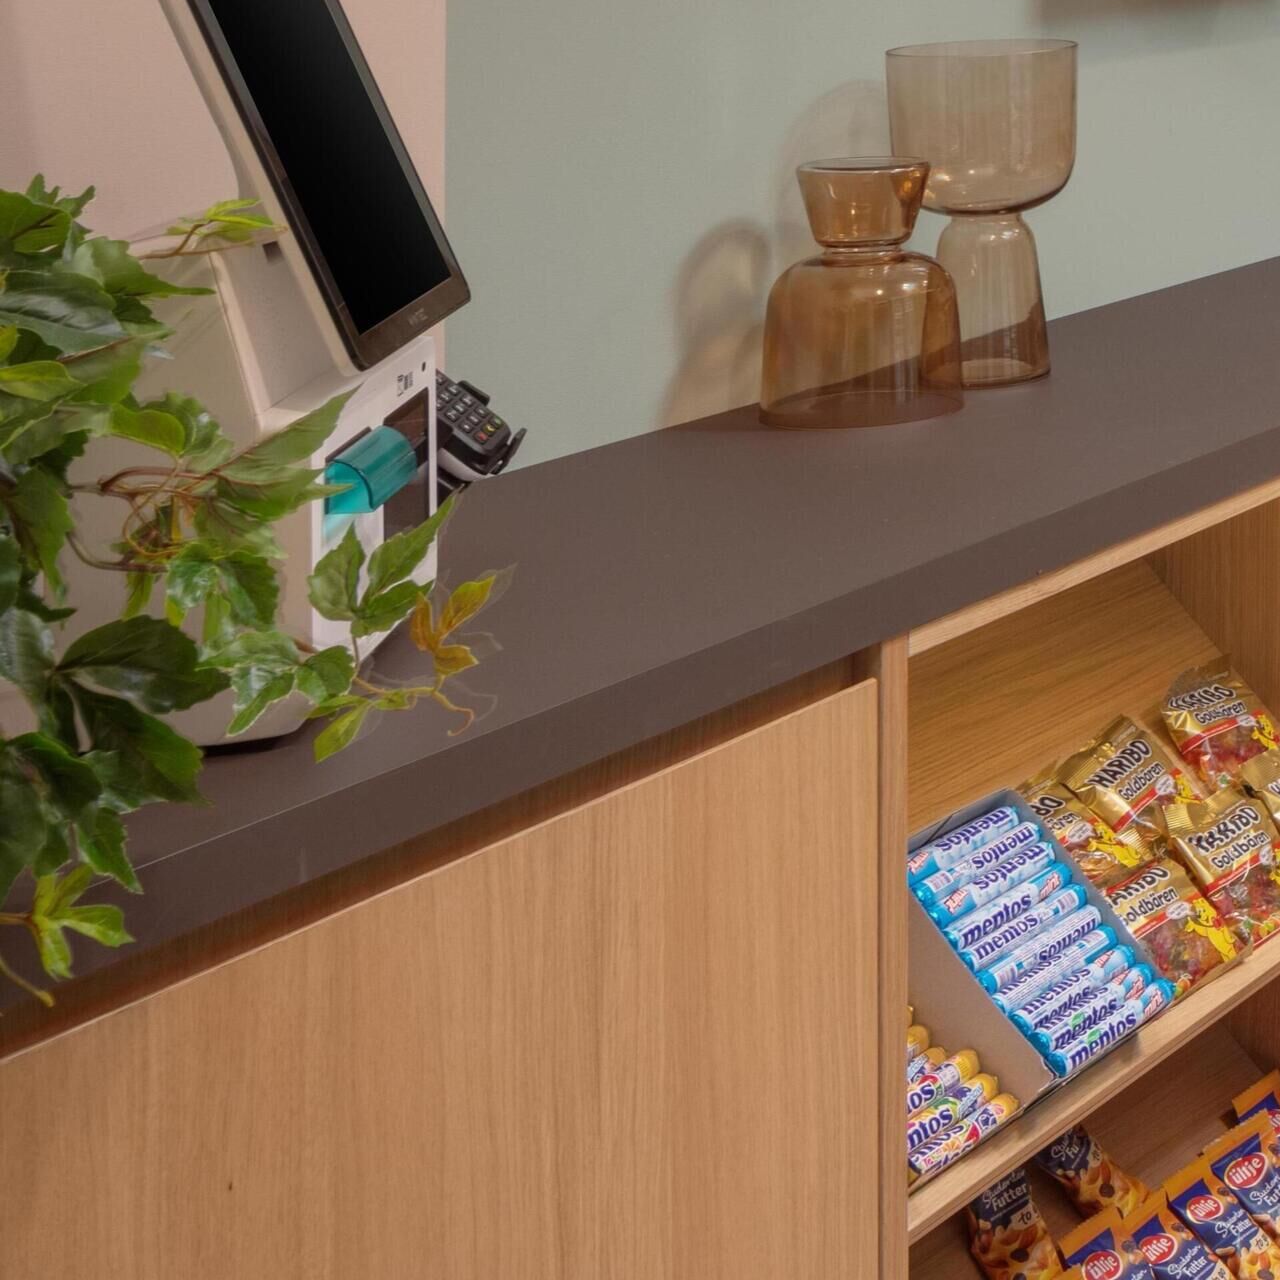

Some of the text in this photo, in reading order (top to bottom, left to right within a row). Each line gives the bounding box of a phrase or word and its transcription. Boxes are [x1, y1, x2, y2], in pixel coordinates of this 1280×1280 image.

[1169, 684, 1235, 712] HARIBO
[1086, 739, 1151, 788] HARIBO
[1118, 762, 1164, 801] Goldbären
[935, 808, 1011, 852] mentos
[971, 825, 1035, 870] mentos
[972, 844, 1047, 890] mentos
[1212, 831, 1270, 869] Goldbären
[1038, 874, 1061, 900] mint
[960, 893, 1033, 948] mentos
[975, 913, 1039, 960] mentos
[1144, 989, 1163, 1016] mint
[1053, 997, 1118, 1051] mentos
[1069, 1012, 1137, 1071] mentos
[1228, 1156, 1263, 1185] ültje
[991, 1183, 1028, 1213] Futter
[1192, 1197, 1220, 1219] ültje
[1088, 1254, 1118, 1280] ültje
[1142, 1236, 1172, 1262] ültje
[1183, 1256, 1208, 1278] Futter
